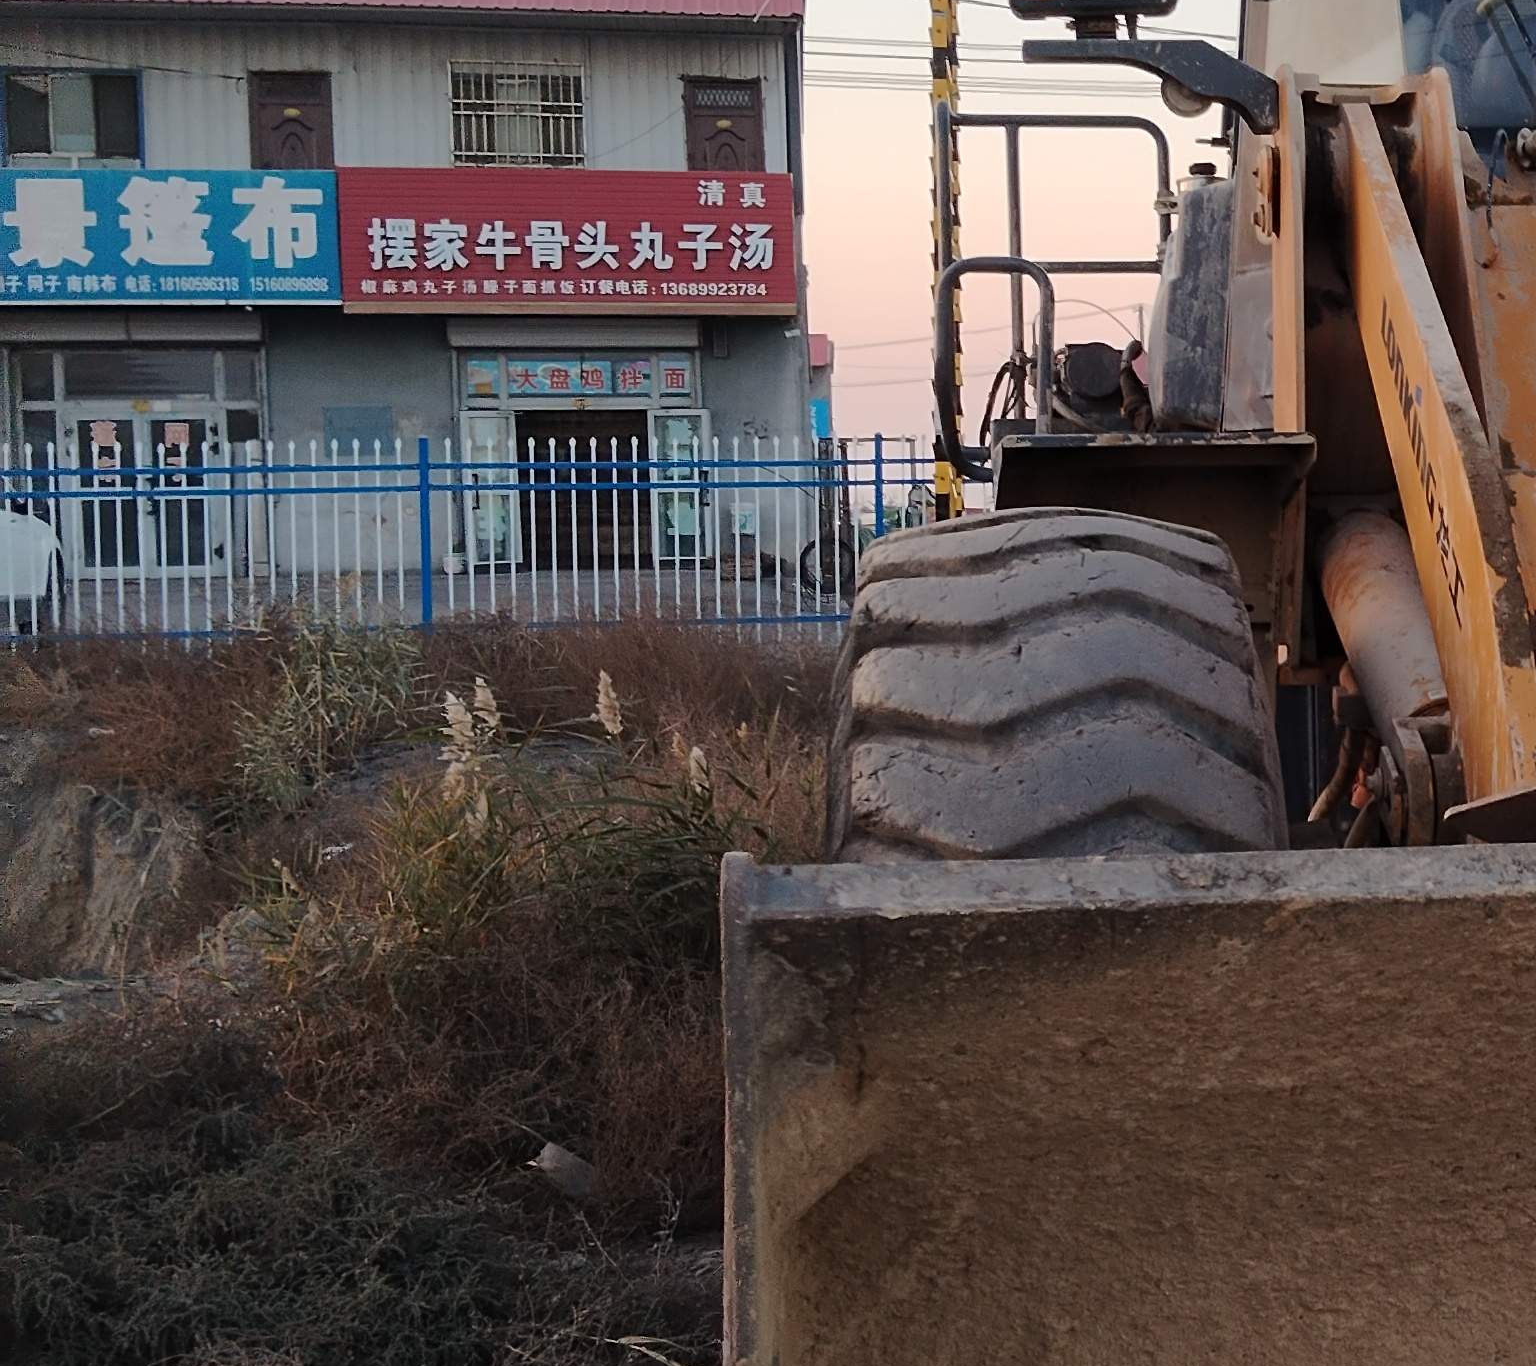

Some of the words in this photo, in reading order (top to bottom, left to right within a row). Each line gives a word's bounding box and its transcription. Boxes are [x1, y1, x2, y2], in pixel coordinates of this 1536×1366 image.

[697, 179, 767, 209] 清真
[366, 217, 774, 272] 摆家牛骨头丸子汤
[516, 367, 686, 390] 大盘鸡拌面
